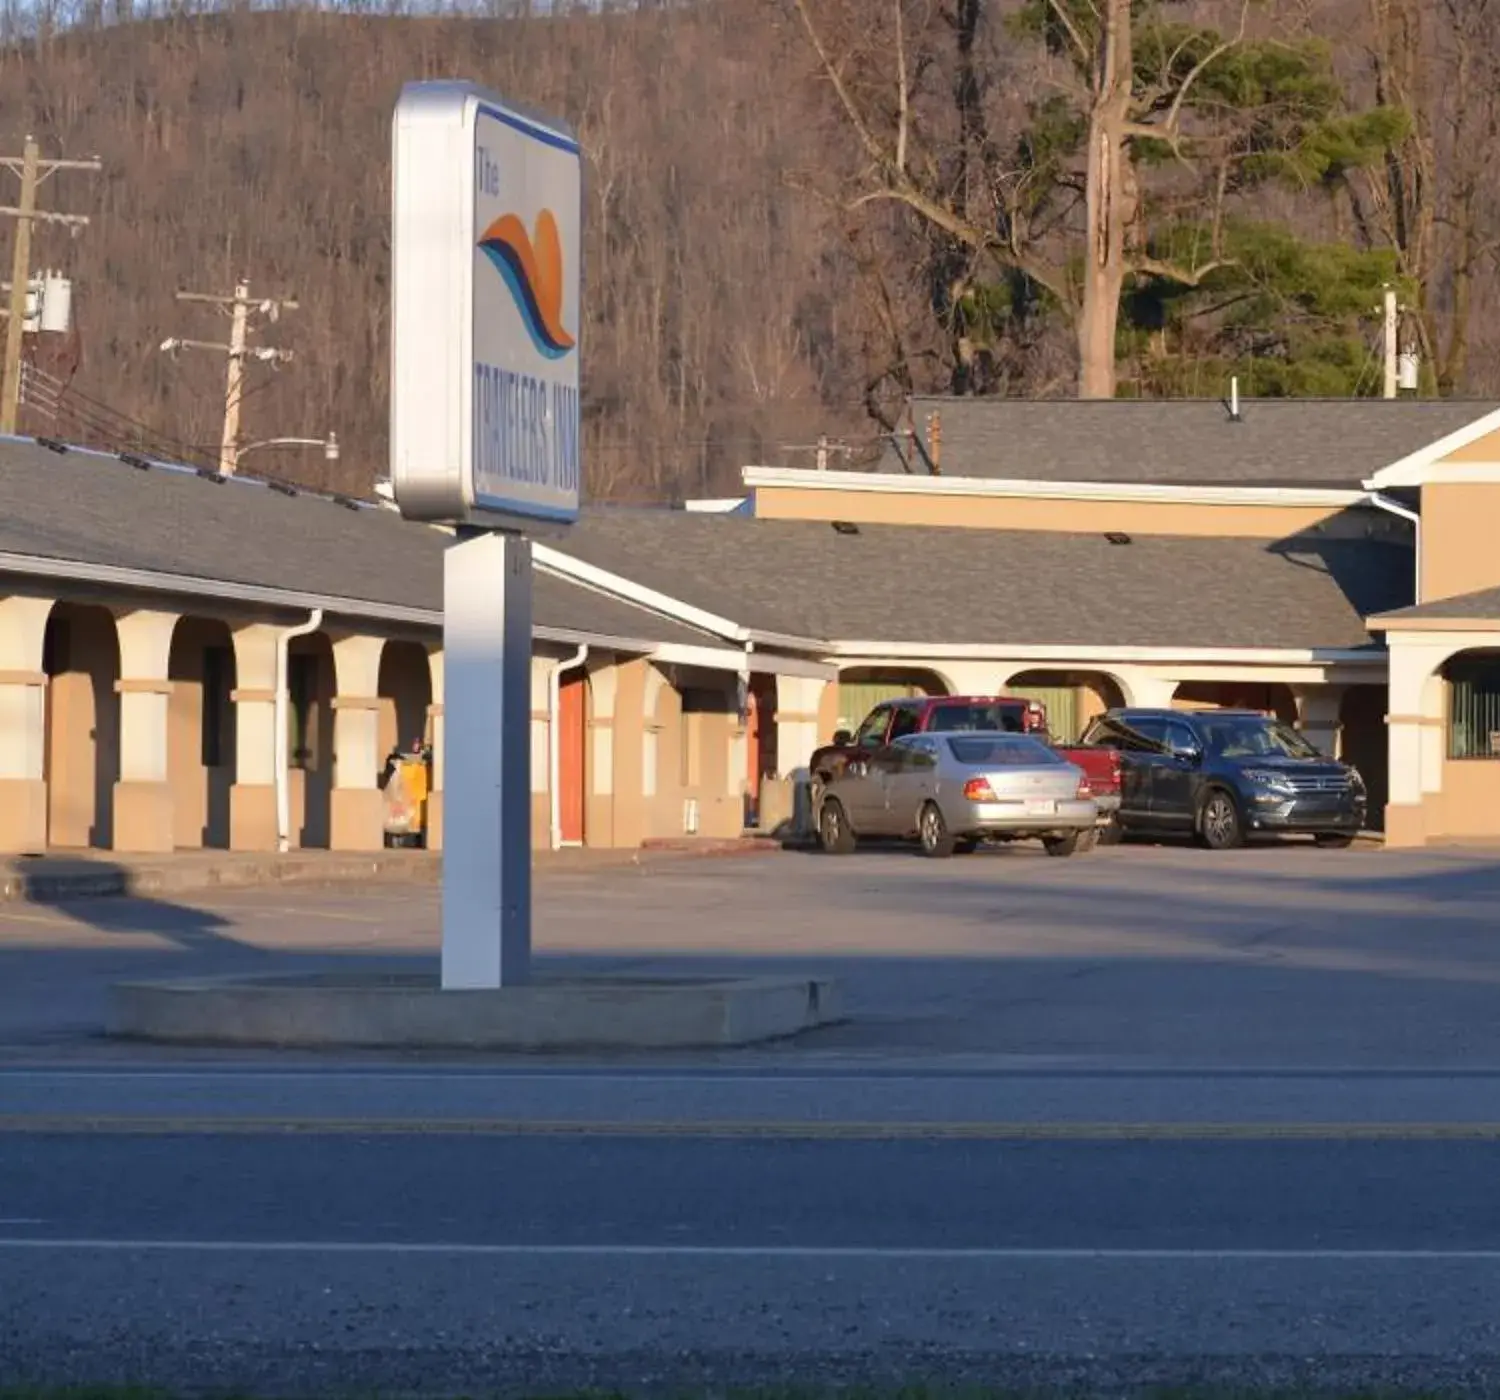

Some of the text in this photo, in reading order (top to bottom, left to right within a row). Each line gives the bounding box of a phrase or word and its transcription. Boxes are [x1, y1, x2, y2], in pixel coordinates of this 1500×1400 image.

[478, 145, 499, 197] The
[477, 361, 577, 492] TRAVELERS INN
